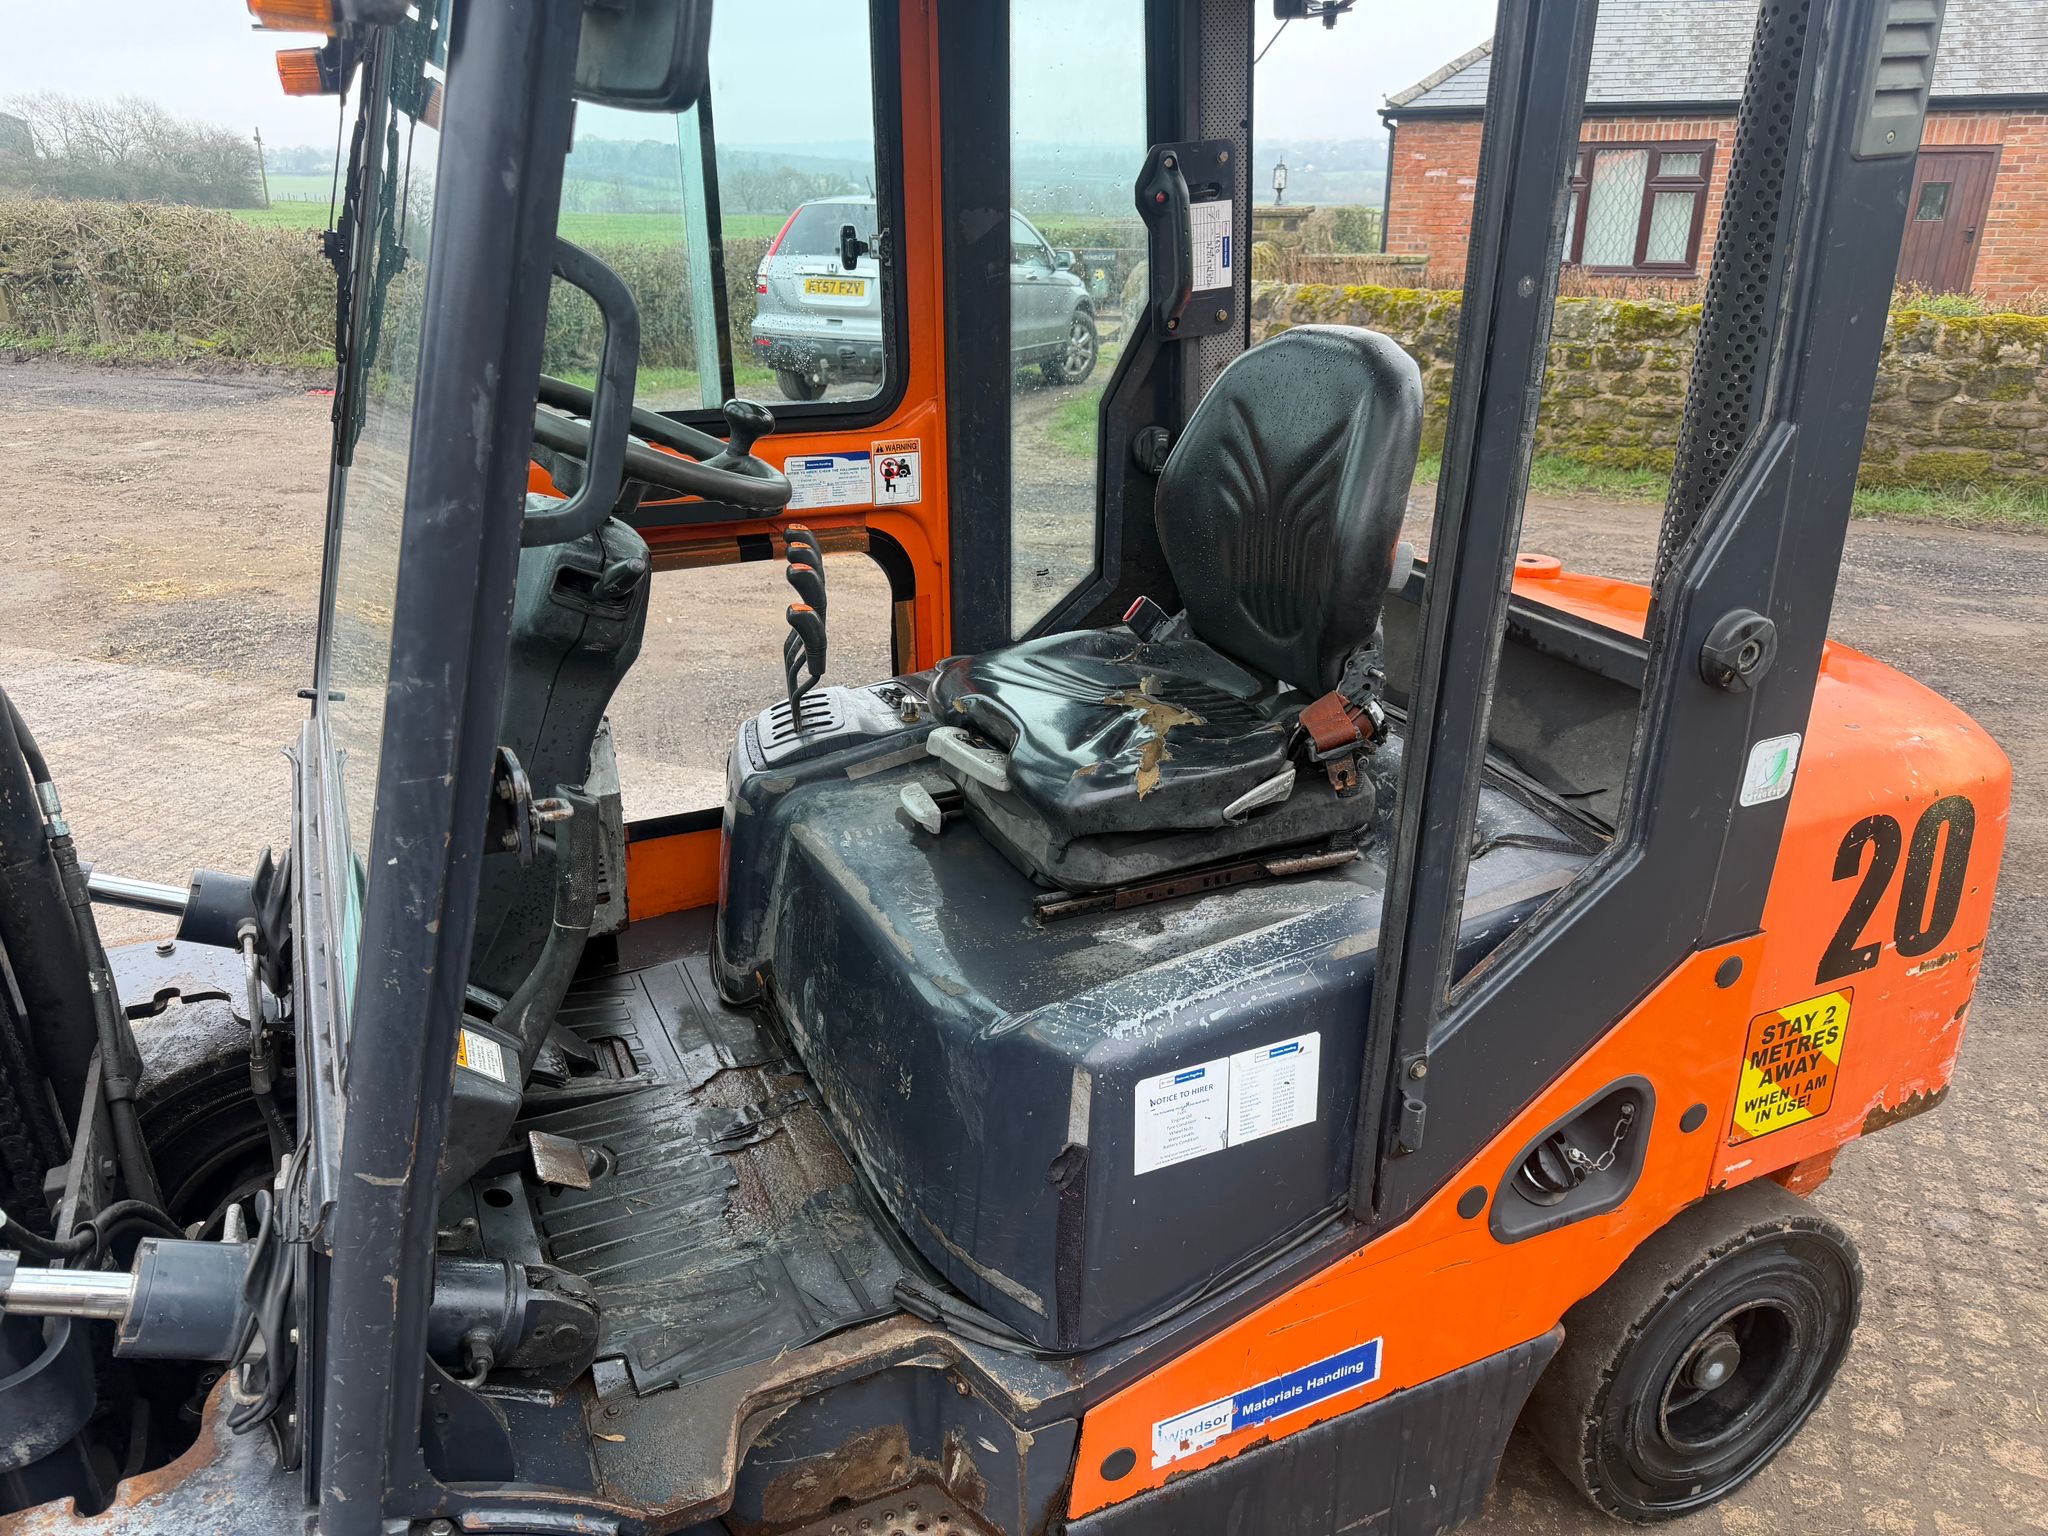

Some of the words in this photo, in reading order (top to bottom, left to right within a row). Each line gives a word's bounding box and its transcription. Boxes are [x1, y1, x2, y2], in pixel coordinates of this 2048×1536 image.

[839, 282, 861, 294] FZY
[885, 443, 917, 452] WARNING
[1815, 795, 1976, 986] 20
[1762, 1011, 1819, 1045] STAY
[1823, 1005, 1837, 1026] 2
[1750, 1025, 1839, 1071] METRES
[1758, 1051, 1823, 1089] AWAY
[1149, 1093, 1178, 1107] NOTICE
[1179, 1090, 1190, 1099] TO
[1191, 1083, 1214, 1095] HIRER
[1744, 1087, 1790, 1114] WHEN
[1794, 1084, 1800, 1096] I
[1804, 1074, 1828, 1093] AM
[1755, 1108, 1772, 1125] IN
[1776, 1094, 1812, 1116] USE!
[1162, 1412, 1230, 1443] Windsor
[1242, 1386, 1303, 1417] Materials
[1306, 1360, 1364, 1391] Handling
